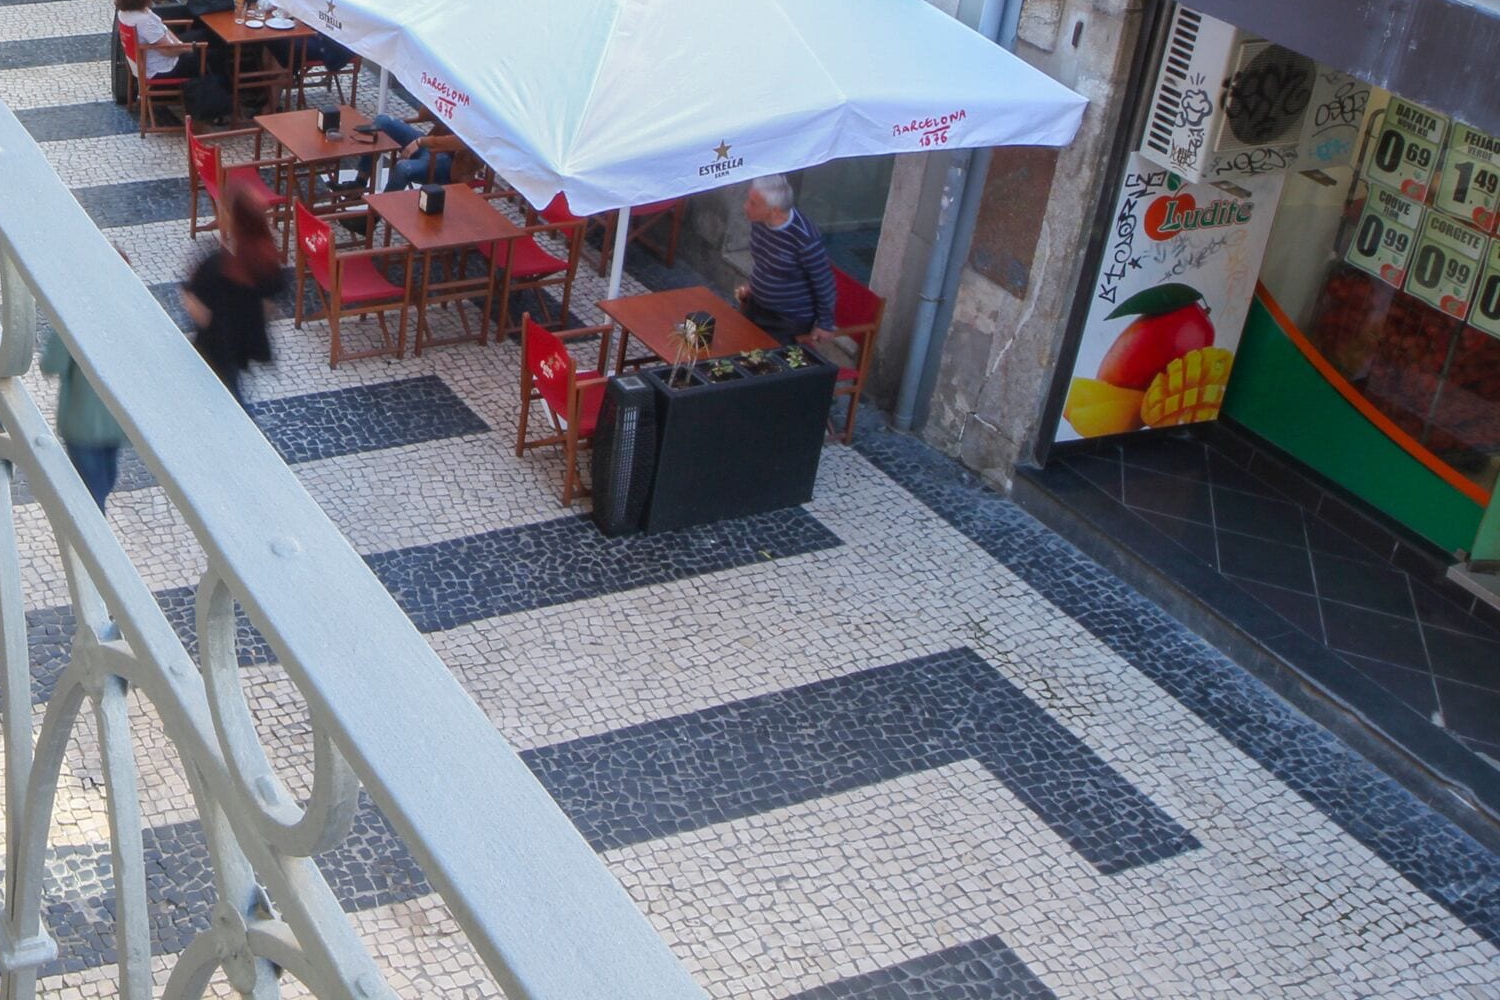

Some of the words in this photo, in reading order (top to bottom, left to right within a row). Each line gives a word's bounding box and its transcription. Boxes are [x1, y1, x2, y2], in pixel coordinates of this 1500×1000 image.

[318, 10, 342, 31] ESTRELLA
[421, 71, 470, 106] BARCELONA
[435, 99, 454, 120] 1876
[1395, 102, 1438, 133] BATATA
[893, 109, 967, 137] BARCELONA
[919, 131, 948, 147] 1876
[699, 157, 744, 177] ESTRELLA
[1378, 190, 1412, 216] COUVE
[1430, 216, 1482, 250] CORGETE
